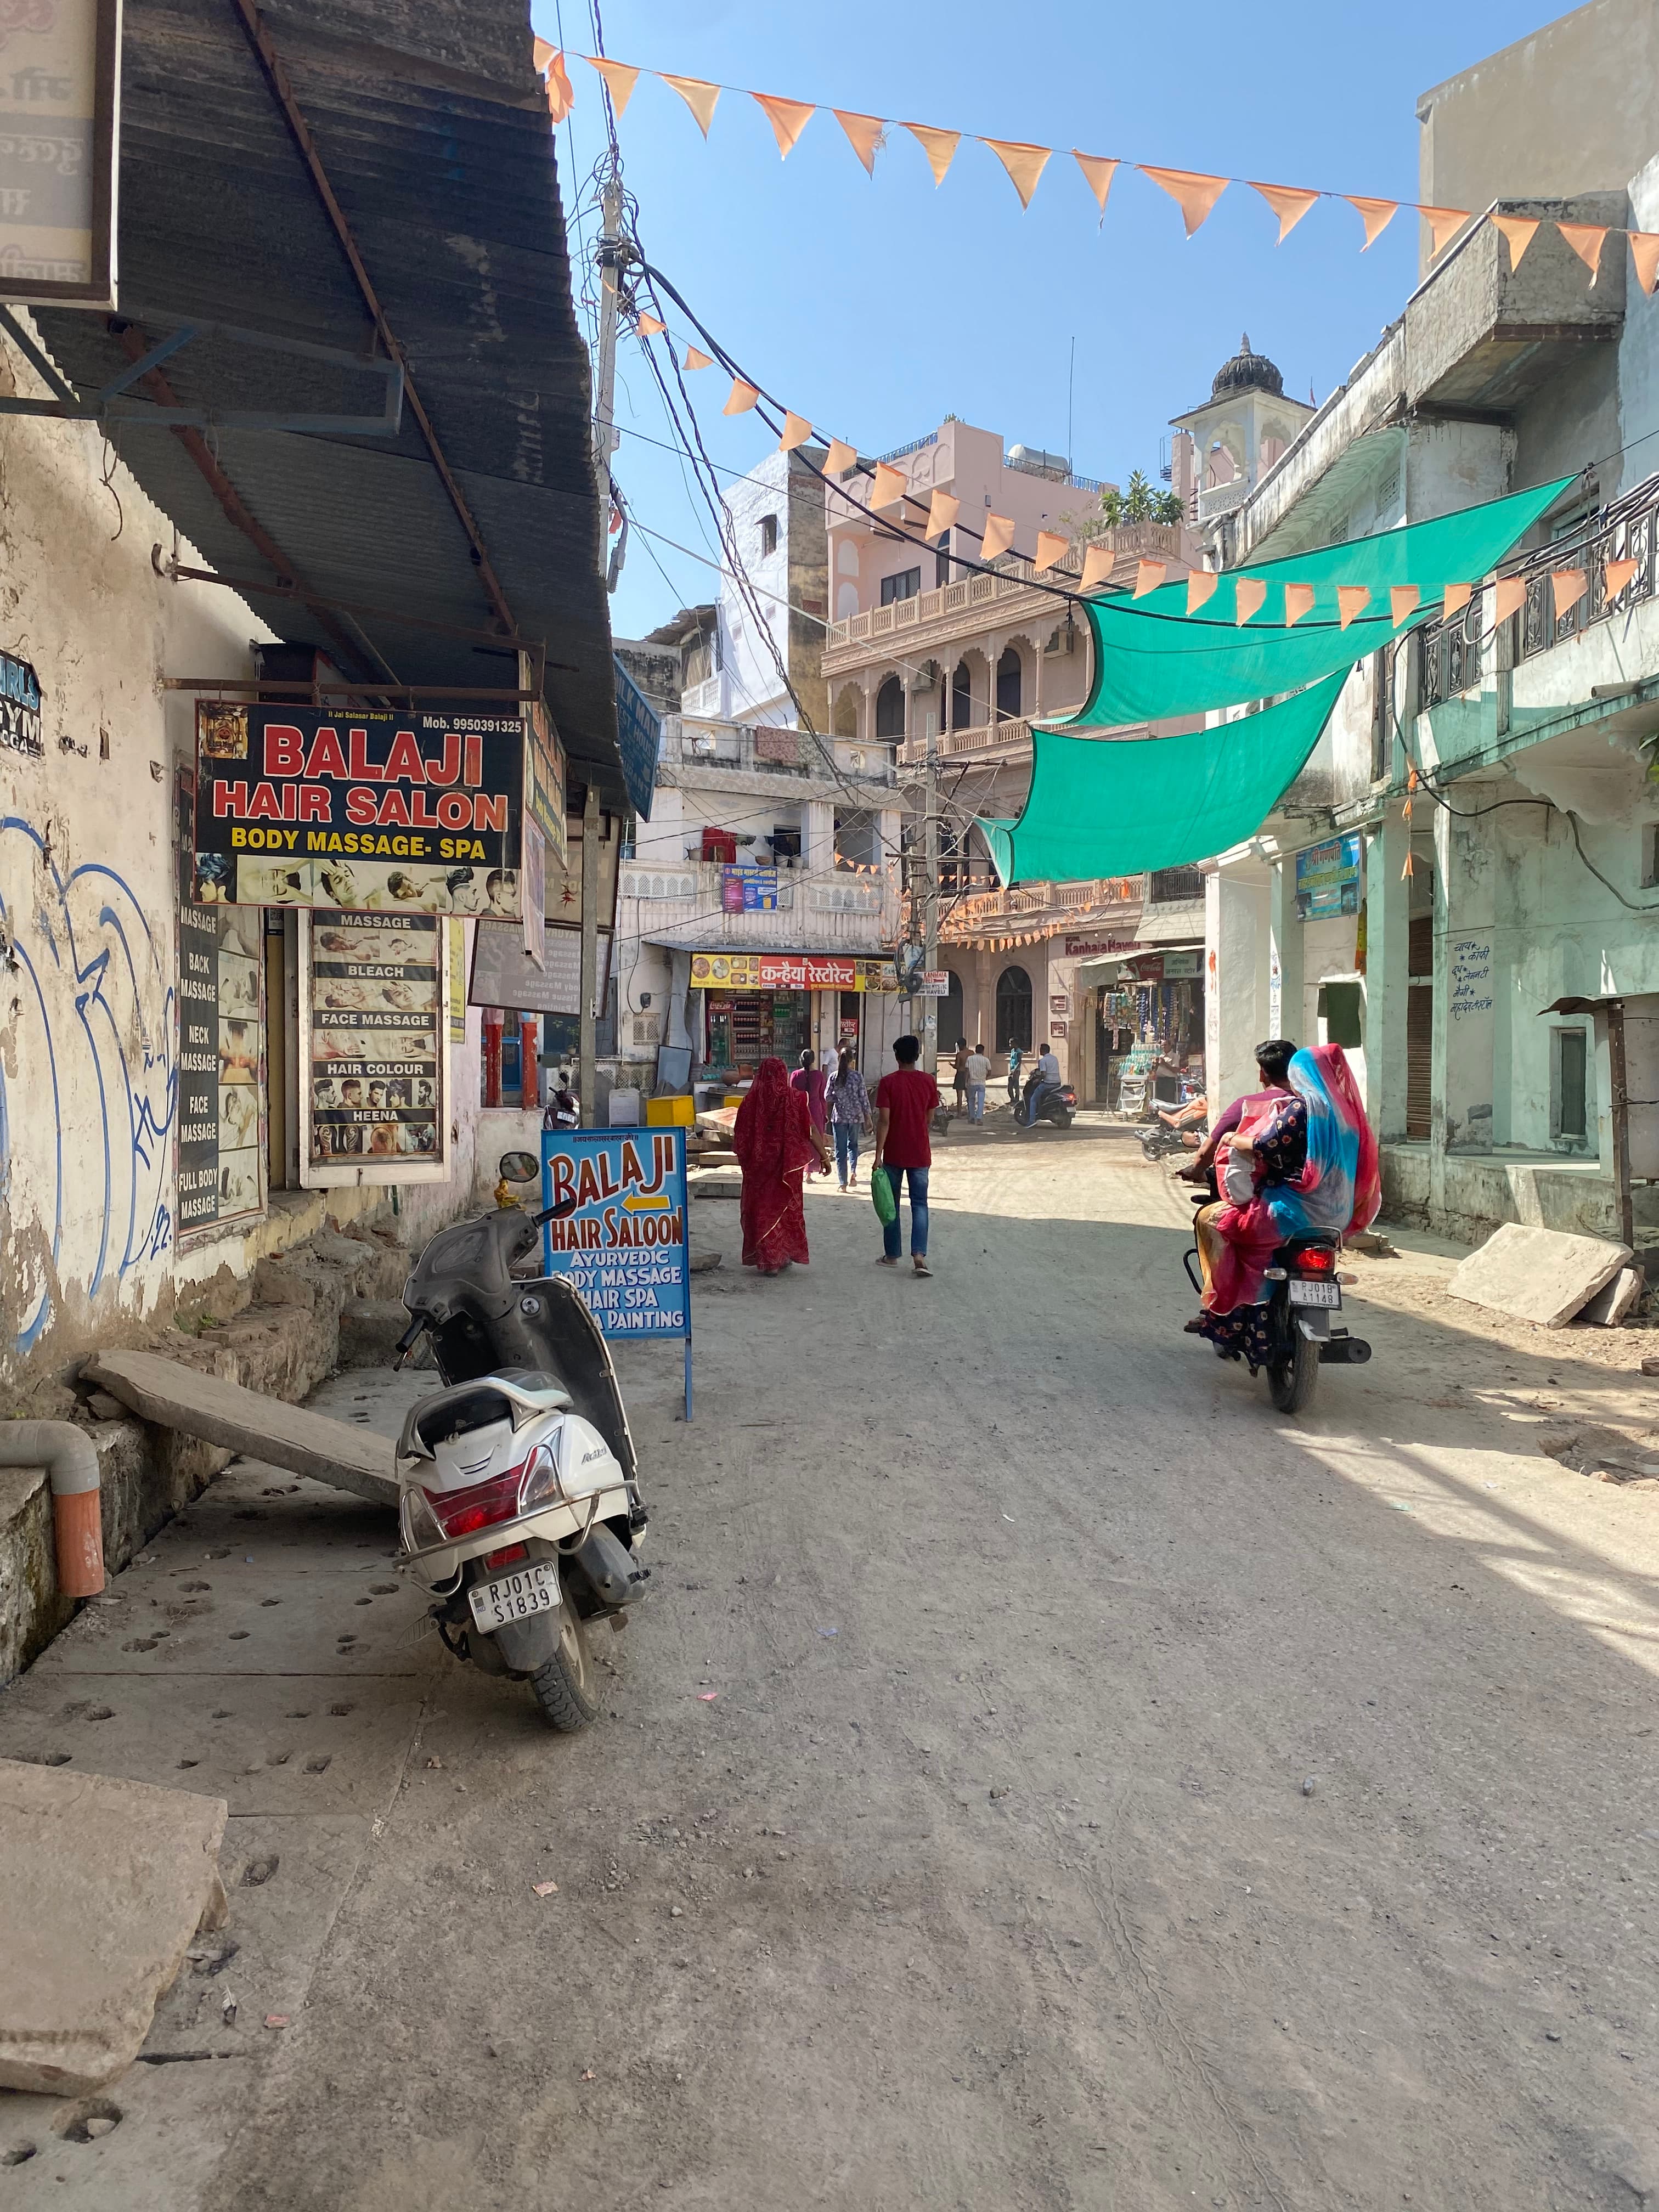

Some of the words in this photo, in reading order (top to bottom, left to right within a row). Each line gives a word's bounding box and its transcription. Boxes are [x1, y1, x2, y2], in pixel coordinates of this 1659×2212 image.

[0, 699, 41, 743] YM
[370, 713, 388, 722] Balaji
[422, 716, 450, 729] Mob.
[453, 718, 522, 733] 9950391325
[263, 724, 483, 787] BALAJI
[213, 780, 332, 823] HAIR
[346, 787, 508, 832] SALON
[231, 827, 299, 850] BODY
[439, 838, 486, 860] SPA
[180, 905, 216, 934] MASSAGE
[340, 913, 411, 930] MASSAGE
[189, 952, 210, 974] BACK
[347, 964, 405, 979] BLEACH
[761, 961, 806, 983] कन्हैया
[808, 961, 854, 983] रेस्टोरेन्ट
[180, 978, 216, 1003] MASSAGE
[321, 1013, 358, 1026] FACE
[362, 1013, 430, 1027] MASSAGE
[189, 1025, 209, 1045] NECK
[180, 1052, 216, 1072] MASSAGE
[326, 1063, 363, 1075] HAIR
[365, 1063, 425, 1076] COLOUR
[189, 1096, 208, 1114] FACE
[352, 1110, 399, 1122] HEENA
[180, 1122, 216, 1143] MASSAGE
[178, 1171, 197, 1192] FULL
[198, 1167, 218, 1187] BODY
[548, 1135, 677, 1219] BALAJI
[181, 1193, 216, 1220] MASSAGE
[550, 1216, 603, 1253] HAIR
[603, 1206, 684, 1251] SALOON
[570, 1250, 670, 1268] AYURVEDIC
[601, 1267, 683, 1287] MASSAGE
[580, 1290, 621, 1311] HAIR
[625, 1288, 659, 1308] SPA
[607, 1310, 685, 1330] PAINTING
[489, 1568, 545, 1603] RJ01C
[476, 1606, 486, 1614] IND
[494, 1588, 550, 1623] S1839
